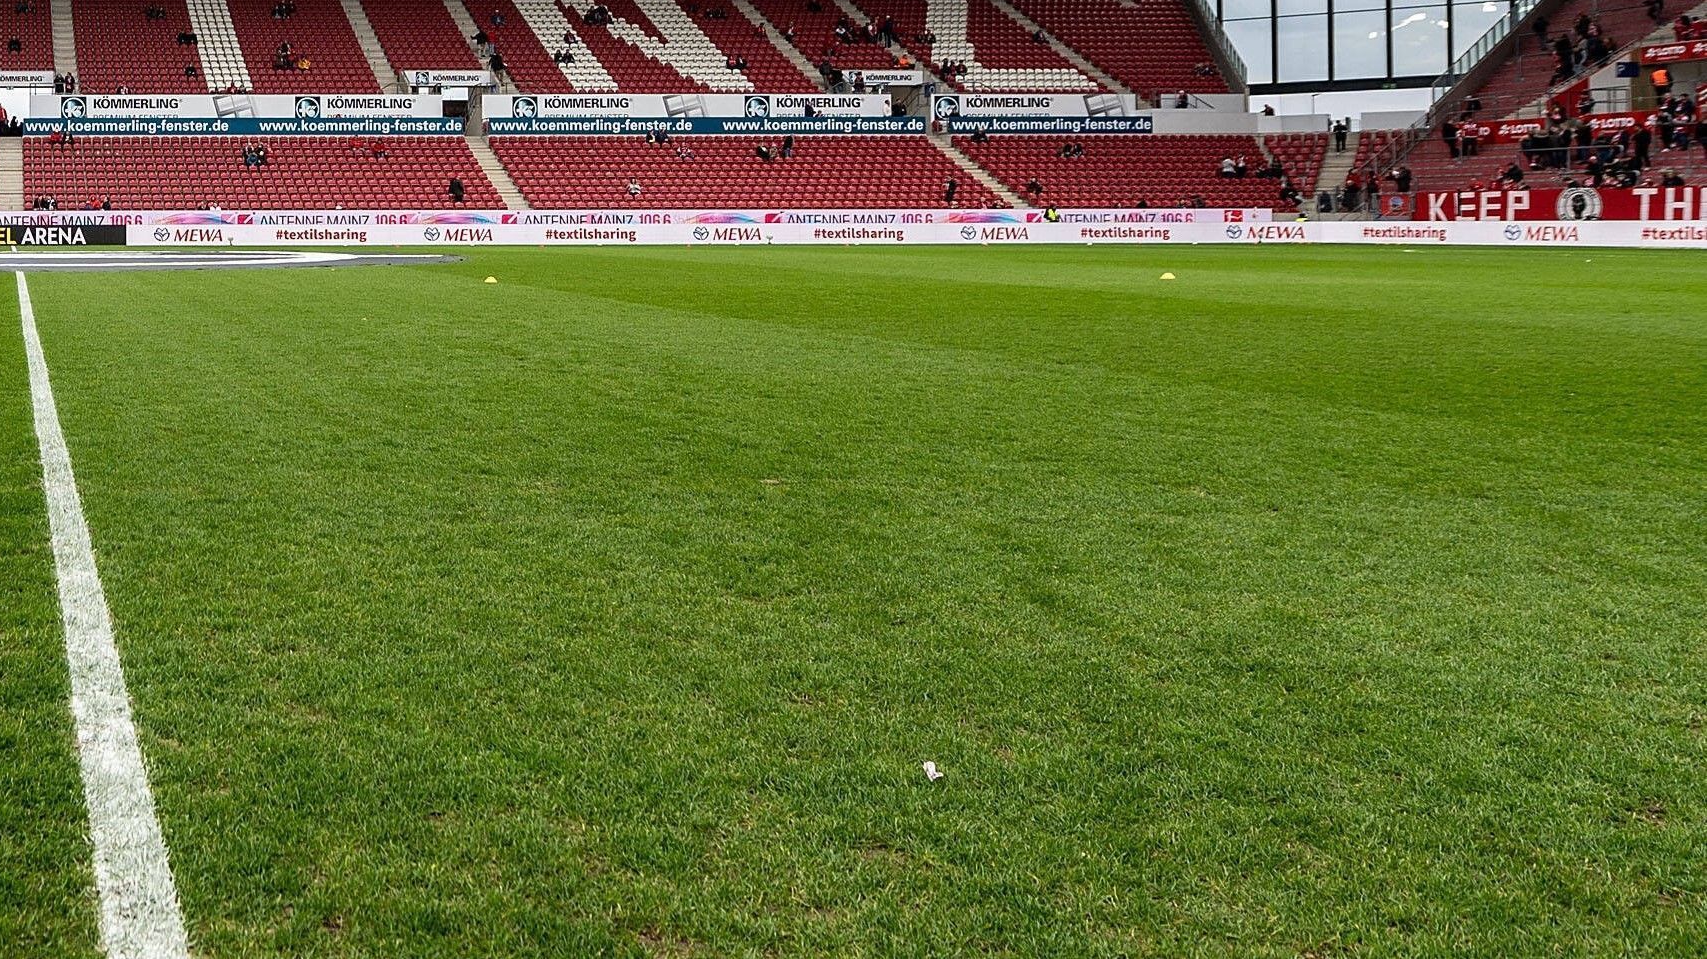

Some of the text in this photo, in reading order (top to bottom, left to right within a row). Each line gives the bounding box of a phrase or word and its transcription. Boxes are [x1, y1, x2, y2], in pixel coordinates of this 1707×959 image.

[432, 74, 480, 82] KÖMMERLING
[93, 96, 178, 109] KÖMMERLING
[327, 96, 412, 109] KÖMMERLING
[544, 96, 629, 108] KÖMMERLING
[776, 95, 860, 108] KÖMMERLING
[966, 95, 1050, 108] KÖMMERLING
[26, 119, 229, 134] www.koemmerling-fenster.de
[260, 119, 462, 134] www.koemmerling-fenster.de
[490, 118, 692, 134] www.koemmerling-fenster.de
[722, 118, 924, 133] www.koemmerling-fenster.de
[952, 118, 1152, 133] www.koemmerling-fenster.de
[1428, 190, 1530, 221] KEEP
[21, 229, 86, 245] ARENA
[174, 230, 223, 242] MEWA
[276, 229, 367, 242] #textilsharing
[445, 229, 493, 241] MEWA
[546, 228, 636, 242] #textilsharing
[713, 228, 762, 240] MEWA
[814, 228, 904, 241] #textilsharing
[981, 227, 1029, 240] MEWA
[1081, 227, 1170, 240] #textilsharing
[1247, 226, 1304, 239] MEWA
[1363, 226, 1446, 242] #textilsharing
[1526, 226, 1578, 240] MEWA
